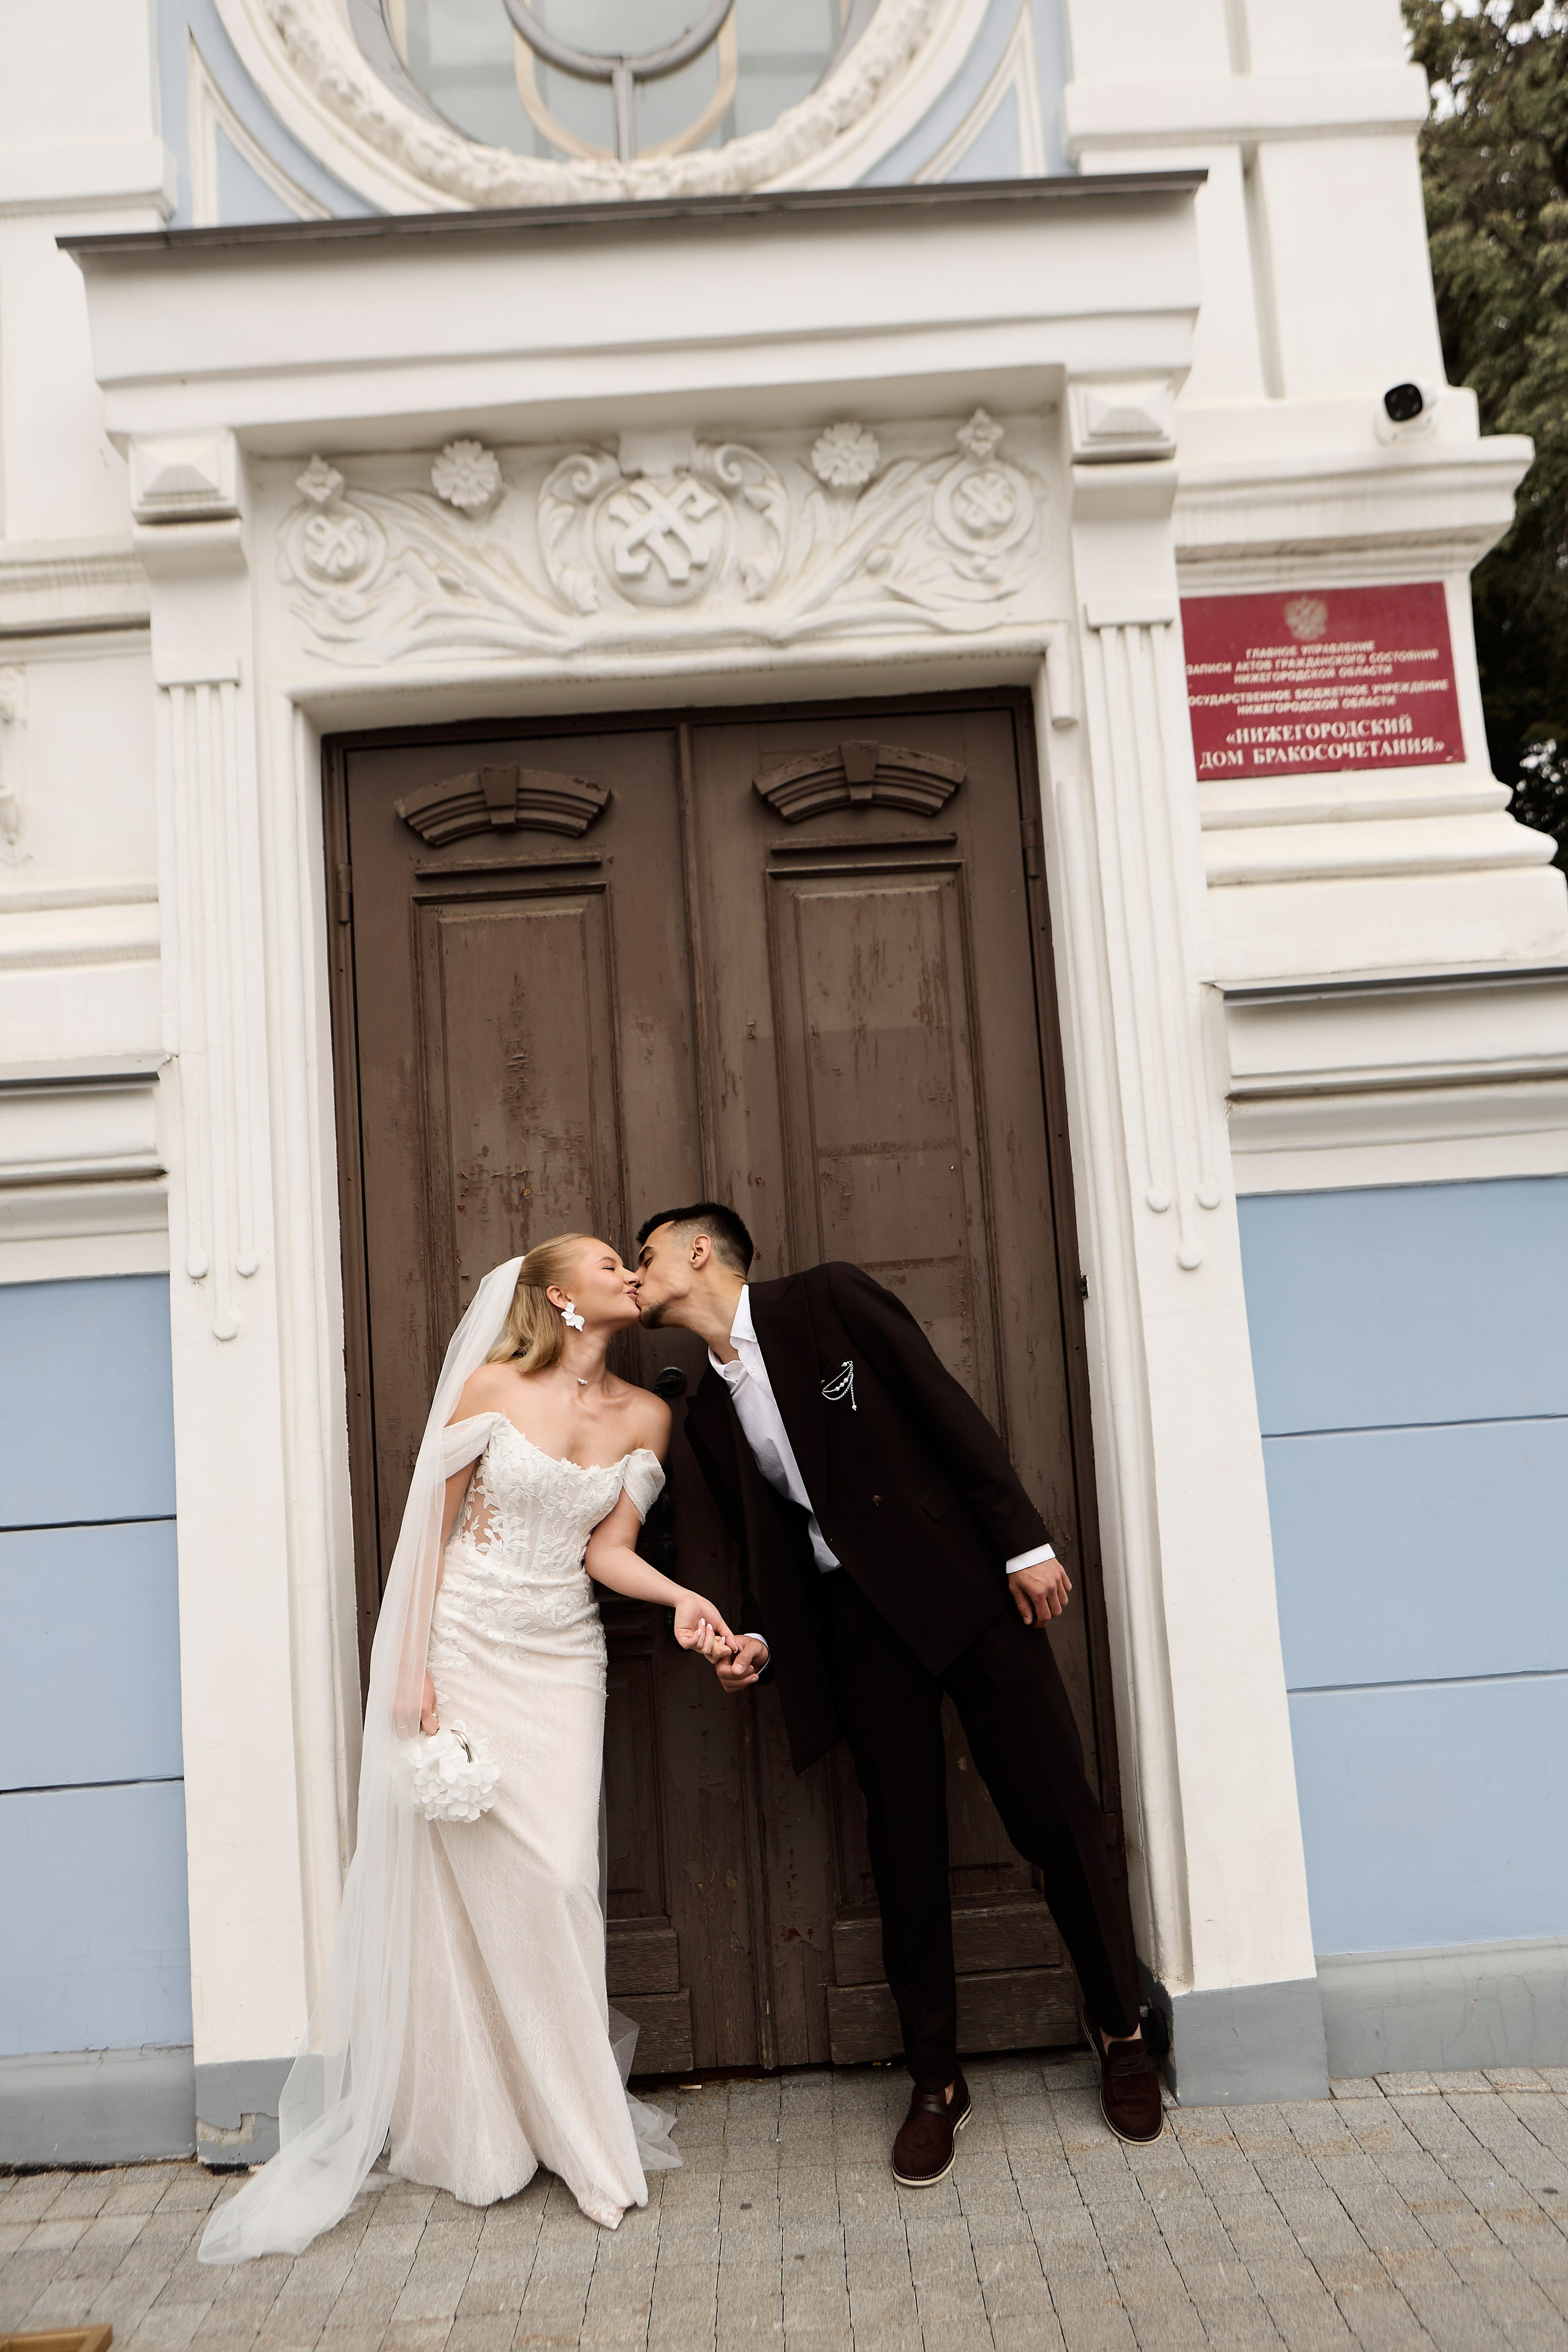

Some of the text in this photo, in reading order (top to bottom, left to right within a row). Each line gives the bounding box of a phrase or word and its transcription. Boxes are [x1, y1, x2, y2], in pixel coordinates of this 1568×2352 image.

[1186, 648, 1439, 676] ЗАПИСИ АКТОВ ГРАЖДАНСКОГО СОСТОЯНИЯ
[1246, 640, 1376, 660] ГЛАВНОЕ УПРАВЛЕНИЕ
[1234, 663, 1393, 685] НИЖЕГОРОДСКОЙ ОБЛАСТИ
[1188, 679, 1449, 707] ОСУДАРСТВЕННОЕ БЮДЖЕТНОЕ УЧРЕЖДЕНИЕ
[1237, 694, 1396, 716] НИЖЕГОРОДСКОЙ ОБЛАСТИ
[1226, 714, 1412, 744] «НИЖЕГОРОДСКИЙ
[1199, 736, 1446, 770] ДОМ БРАКОСОЧЕТАНИЯ»
